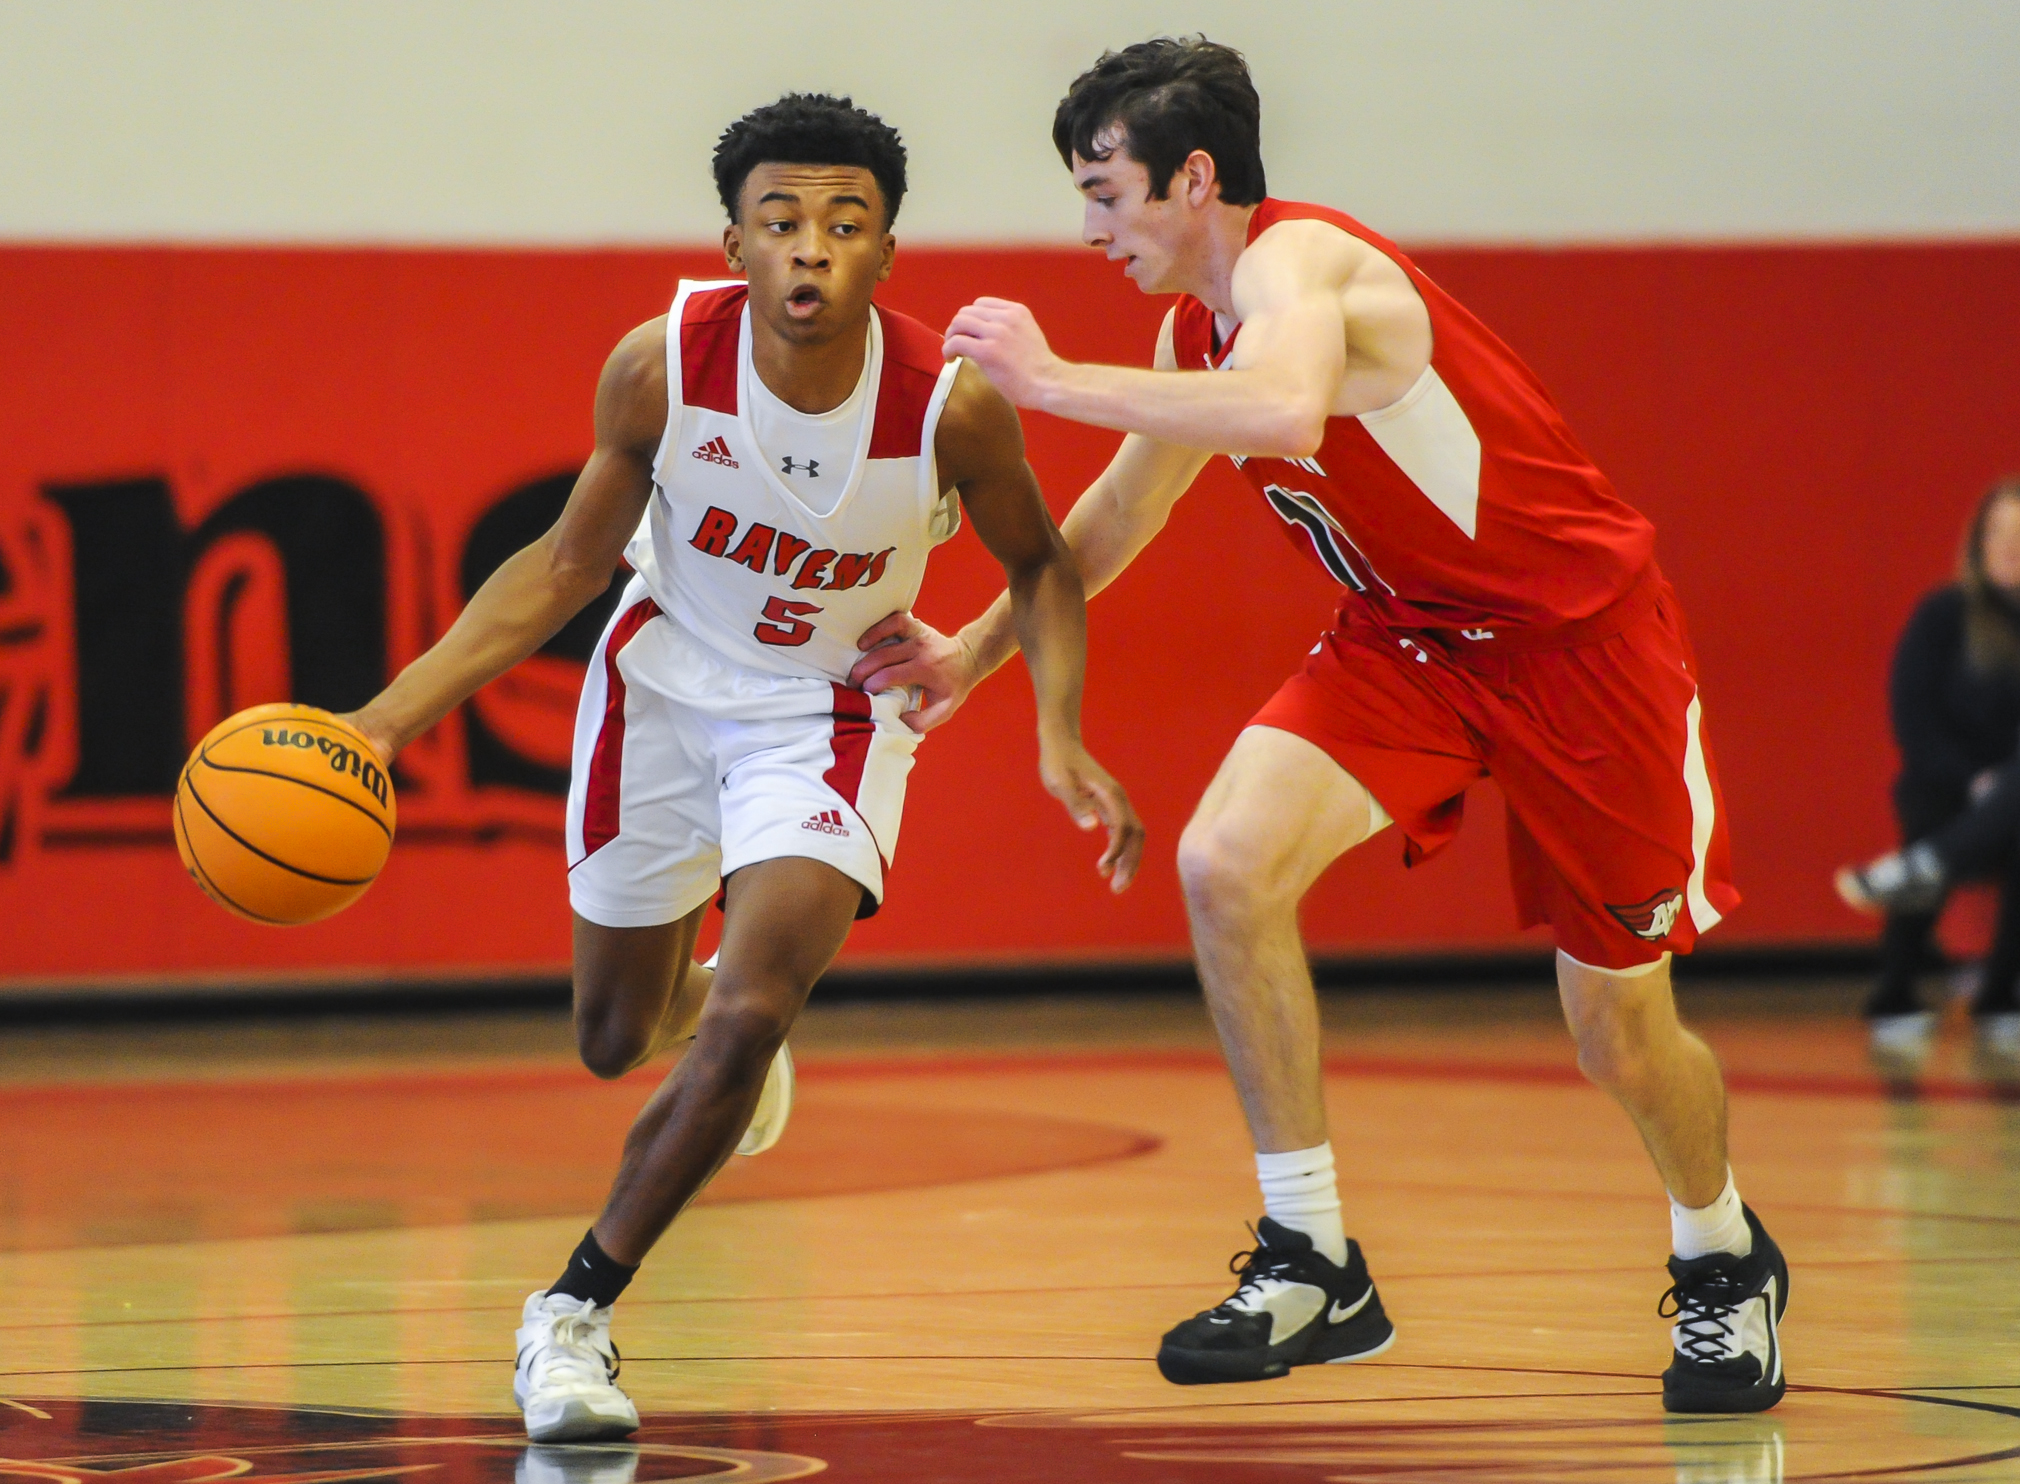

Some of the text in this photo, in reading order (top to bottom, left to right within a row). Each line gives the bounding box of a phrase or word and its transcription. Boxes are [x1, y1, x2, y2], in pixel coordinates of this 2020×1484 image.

[692, 450, 739, 469] adidas
[687, 505, 897, 591] RAVENS
[753, 595, 825, 647] 5
[261, 728, 388, 811] Wilson
[801, 820, 850, 837] adidas
